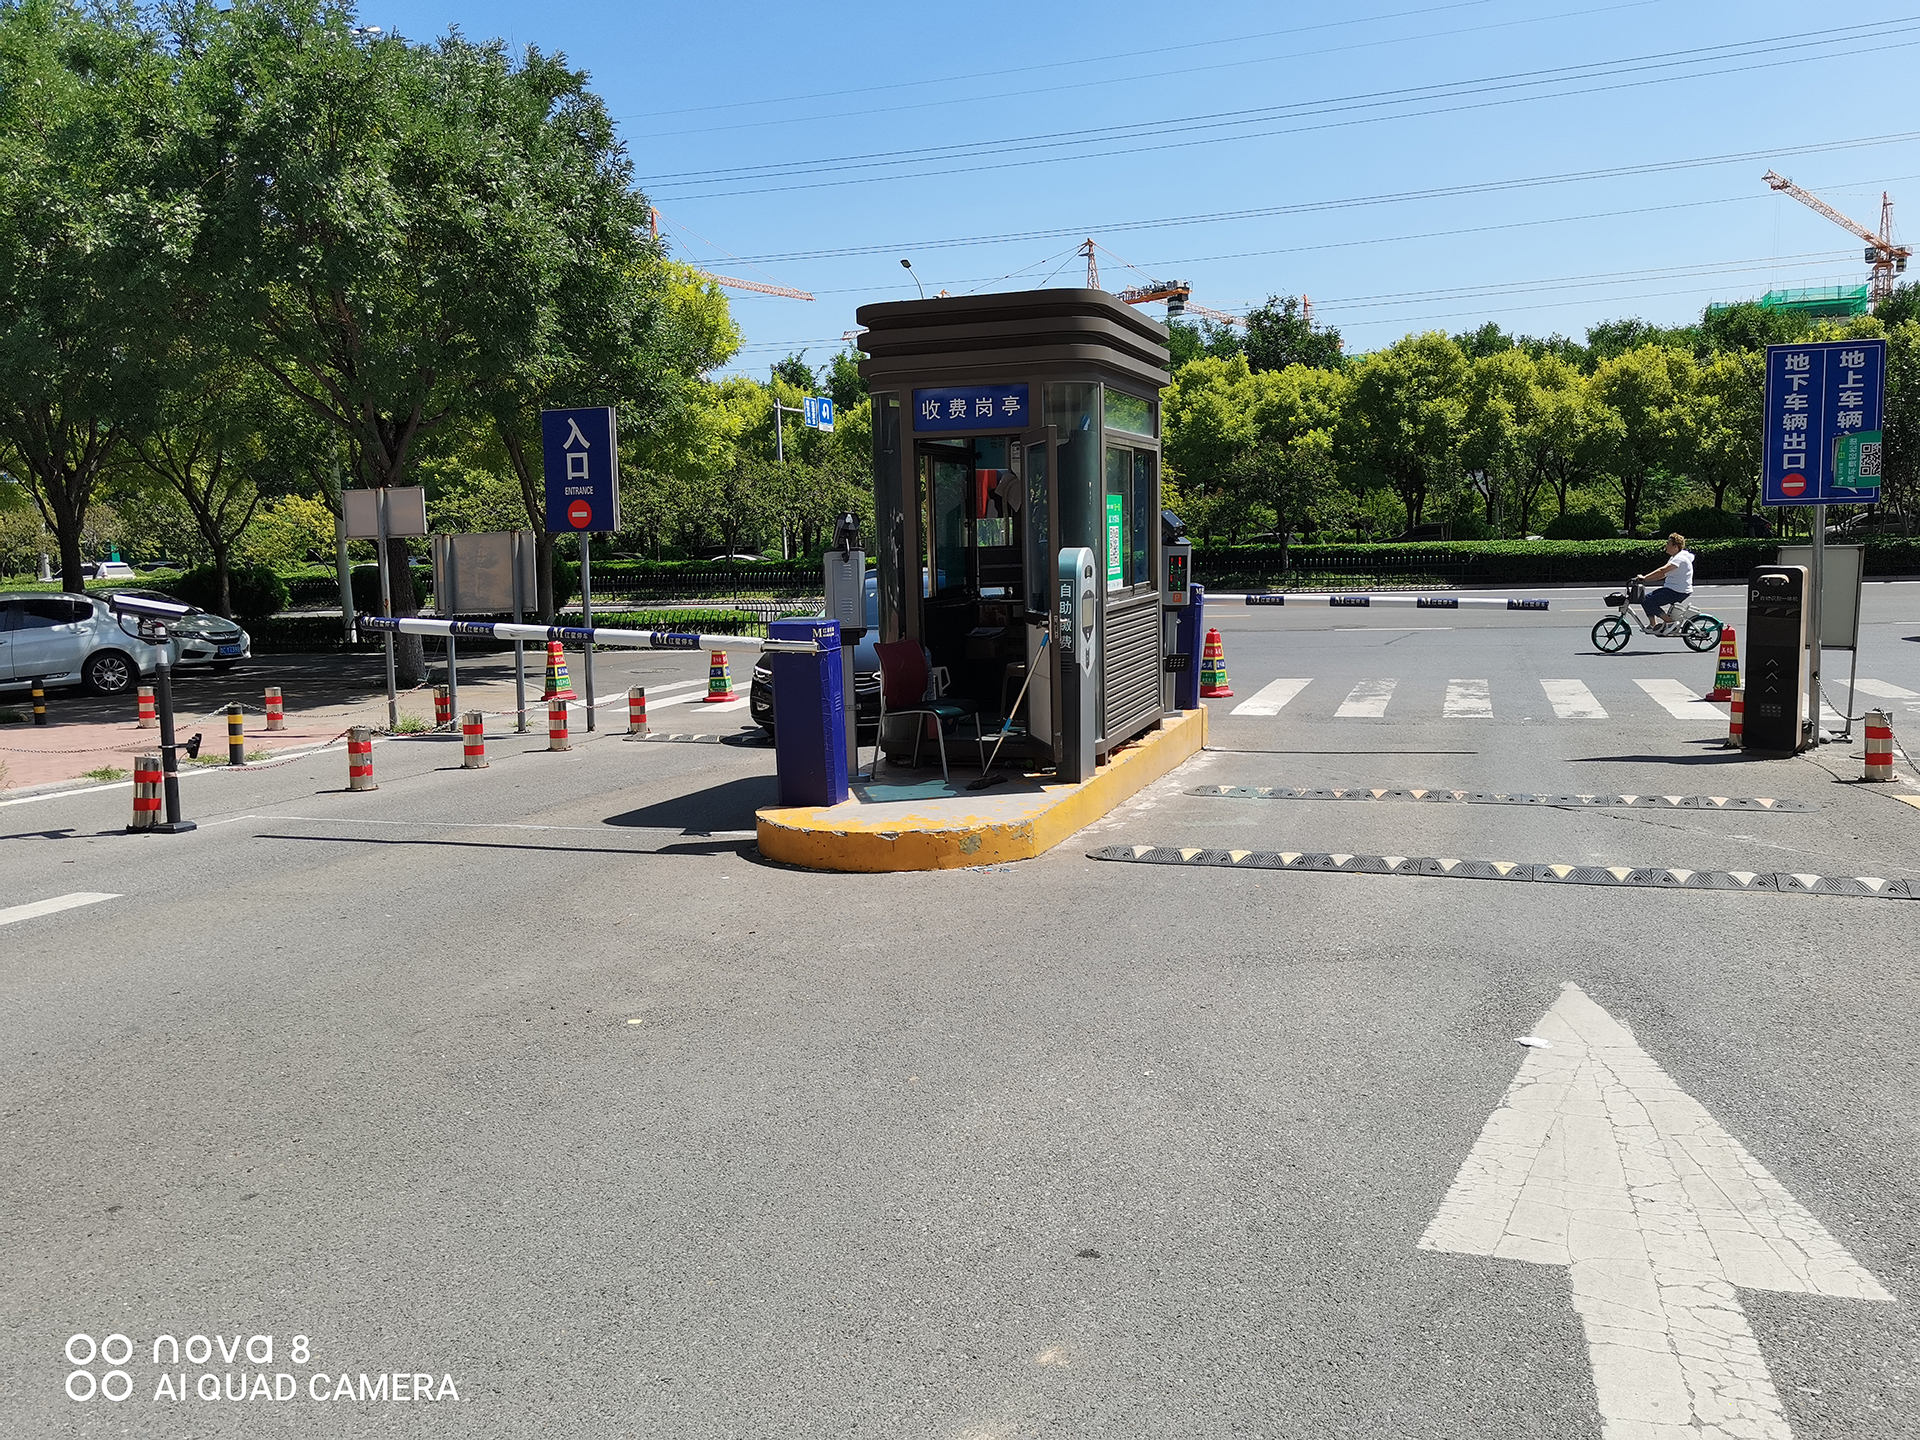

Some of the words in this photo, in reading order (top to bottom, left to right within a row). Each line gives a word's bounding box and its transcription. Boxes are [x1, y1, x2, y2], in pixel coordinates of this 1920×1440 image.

[921, 395, 1021, 420] 收费岗亭
[1783, 353, 1811, 470] 地下车辆出口
[1836, 350, 1866, 436] 地上车辆
[562, 417, 591, 481] 入口
[564, 485, 594, 496] ENTRANCE
[1751, 589, 1760, 602] P
